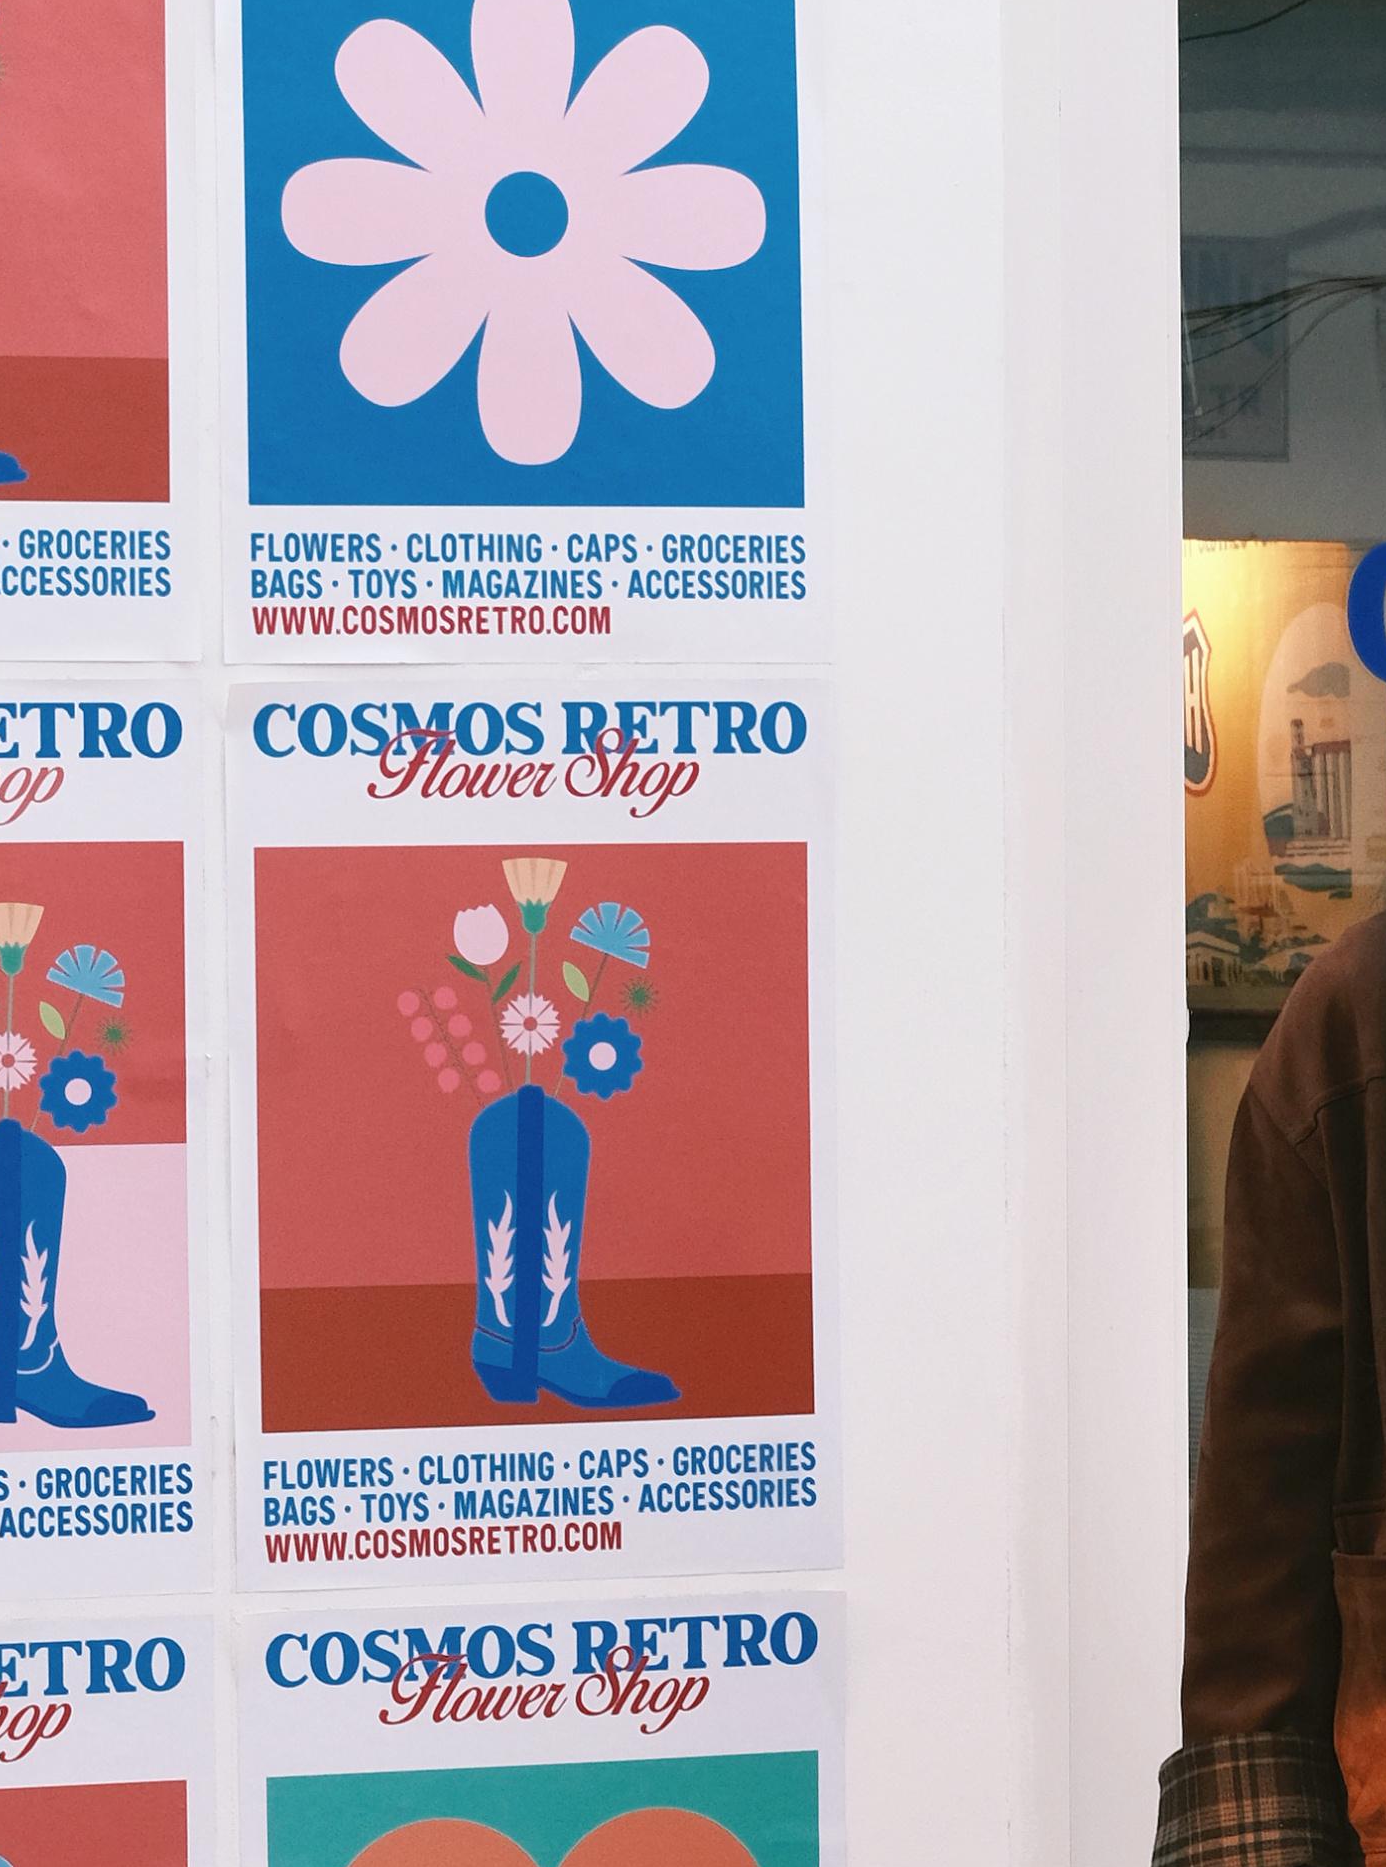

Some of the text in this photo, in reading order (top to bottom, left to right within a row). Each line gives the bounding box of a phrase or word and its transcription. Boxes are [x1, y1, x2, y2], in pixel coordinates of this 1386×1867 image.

[18, 528, 171, 560] GROCERIES
[250, 532, 805, 565] FLOWERS CLOTHING CAPS GROCERIES
[251, 568, 806, 600] BAGS TOYS MAGAZINES ACCESSORIES
[252, 605, 611, 634] WWW.COSMOSRETRO.COM
[253, 700, 808, 757] COSMOS RETRO
[367, 727, 700, 818] Flower Shop
[36, 1463, 193, 1499] GROCERIES
[263, 1441, 816, 1490] FLOWERS CLOTHING CAPS GROCERIES
[263, 1477, 817, 1527] BAGS TOYS MAGAZINES ACCESSORIES
[265, 1521, 622, 1562] WWW.COSMOSRETRO.COM
[265, 1611, 818, 1688] COSMOS RETRO
[379, 1645, 709, 1733] Flower Shop
